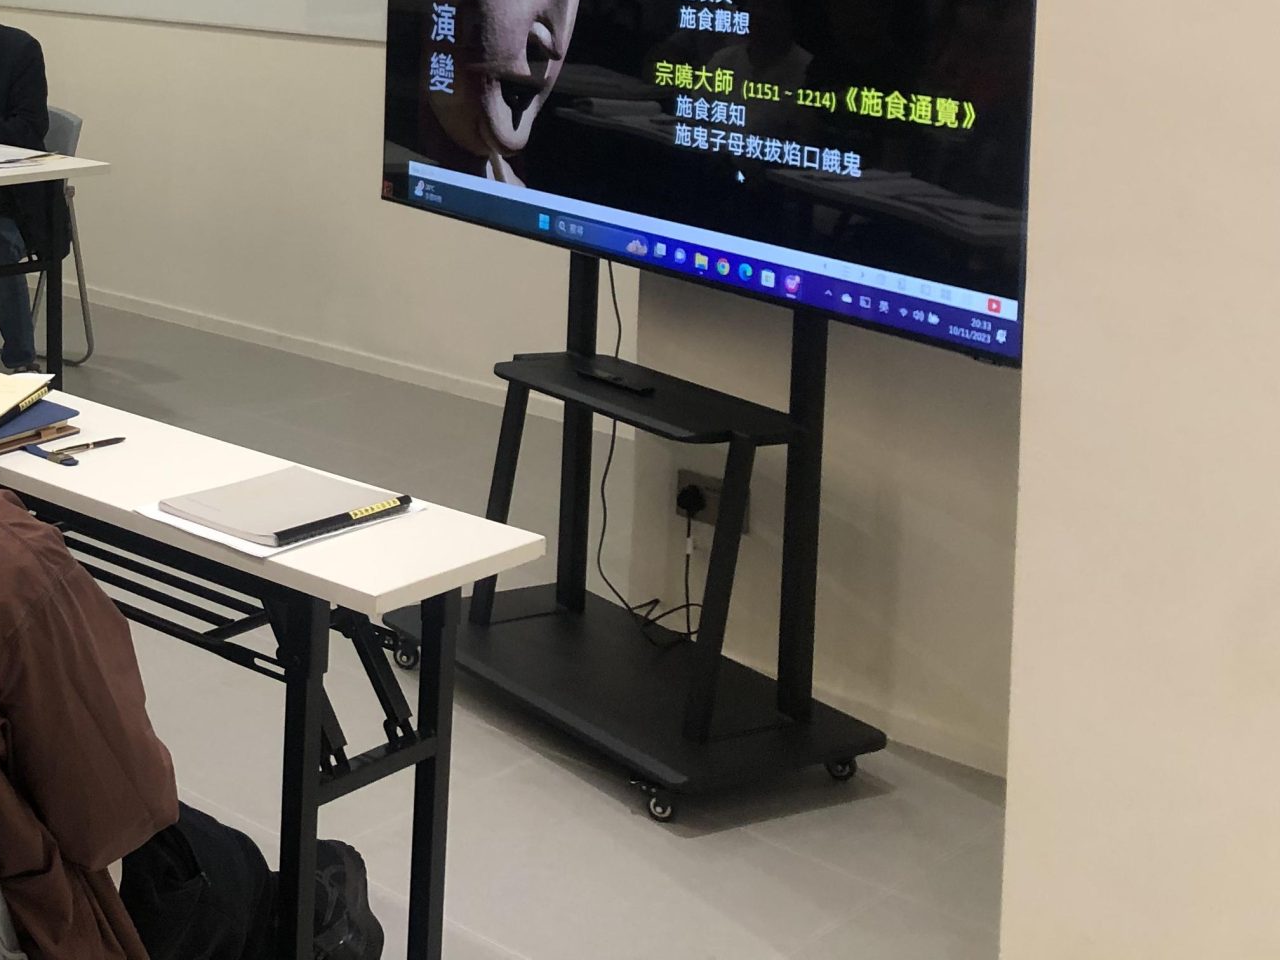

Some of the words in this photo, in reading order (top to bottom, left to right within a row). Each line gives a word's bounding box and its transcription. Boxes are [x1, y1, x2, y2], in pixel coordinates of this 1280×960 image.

[680, 5, 749, 35] 施食觀想
[656, 60, 734, 95] 宗曉大師
[743, 80, 780, 101] (1151
[797, 89, 836, 112] 1214)
[676, 94, 746, 127] 施食須知
[675, 122, 862, 177] 施鬼子母救拔焰口餓鬼
[948, 325, 991, 344] 10/11/2023
[971, 318, 992, 331] 20:33
